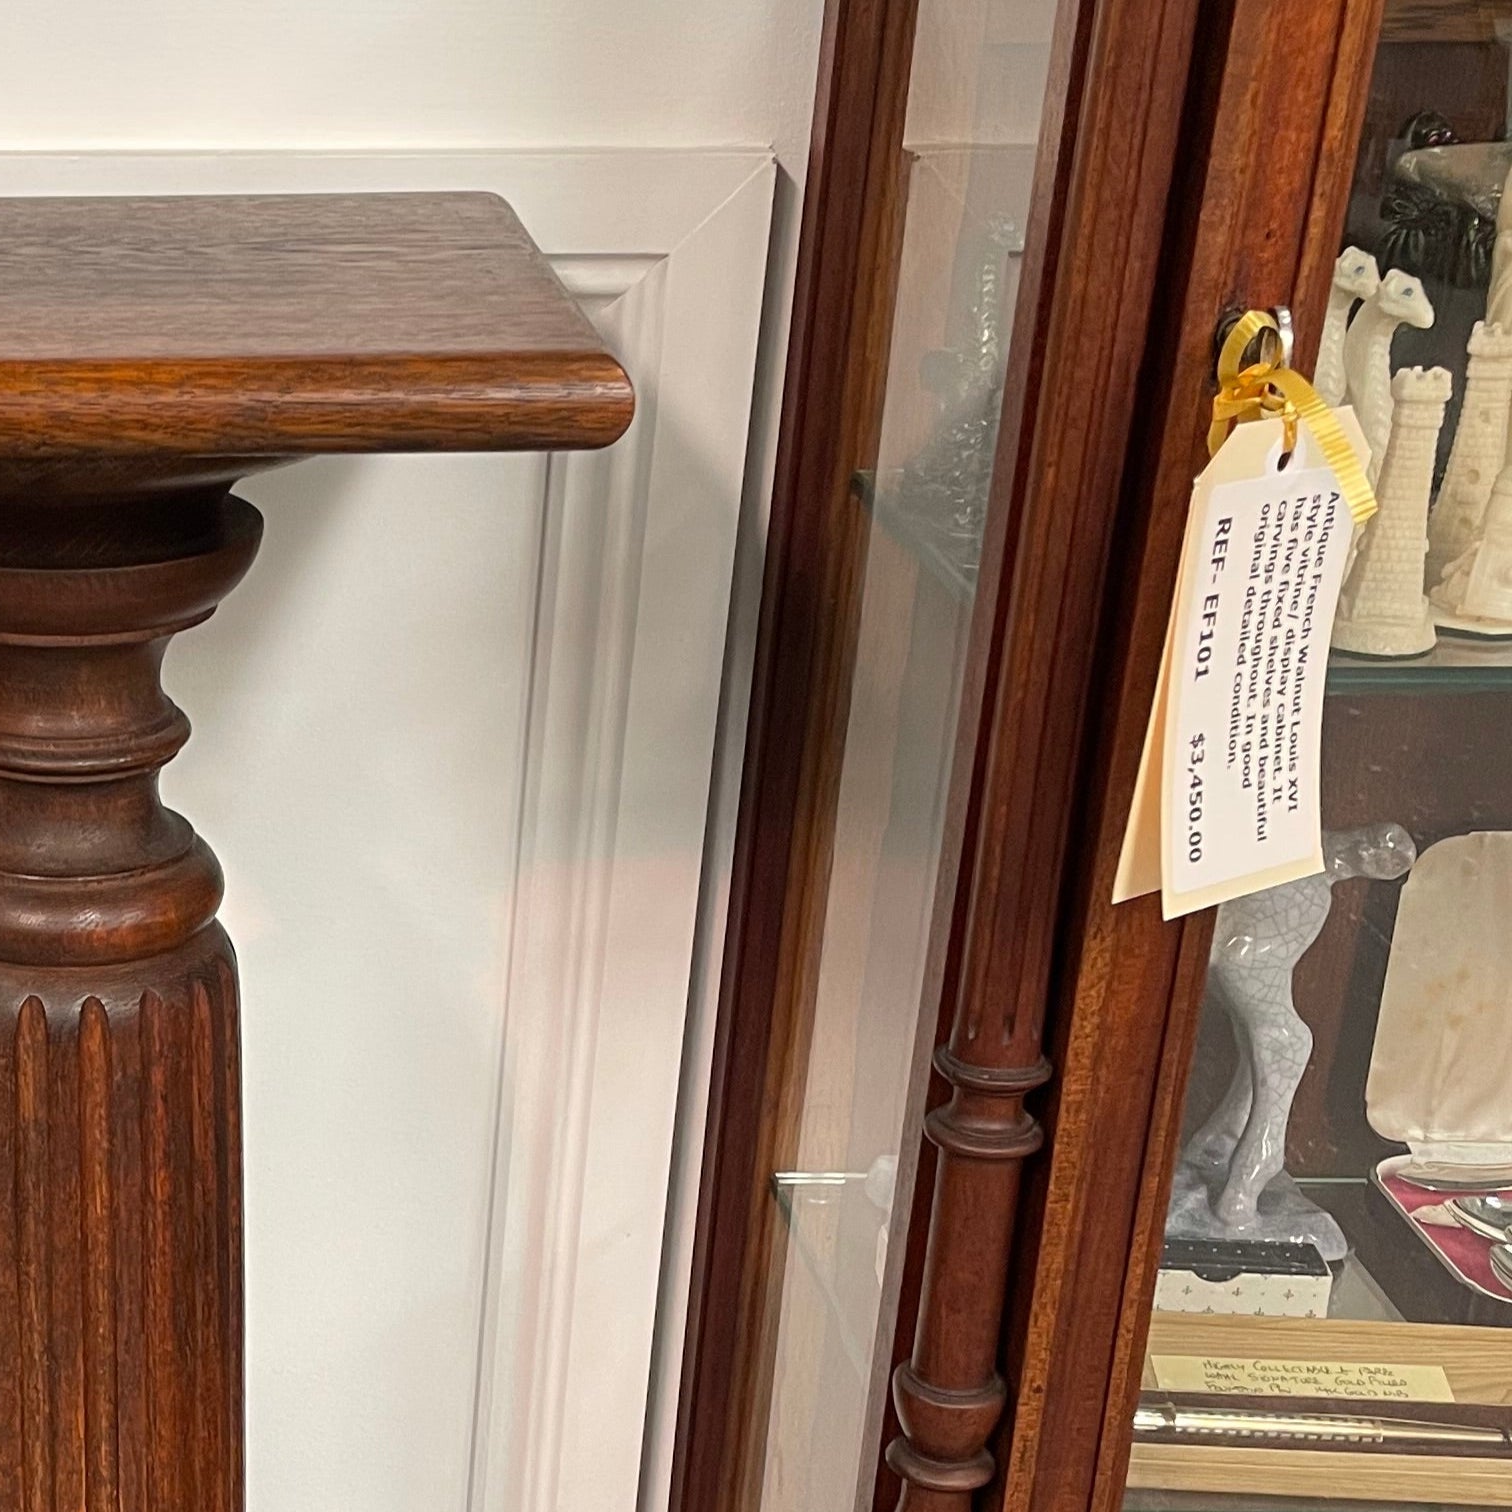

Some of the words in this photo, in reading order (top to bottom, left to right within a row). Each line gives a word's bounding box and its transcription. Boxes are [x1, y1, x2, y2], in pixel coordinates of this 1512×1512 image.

[1248, 504, 1271, 580] original
[1263, 500, 1288, 585] carvings
[1290, 497, 1307, 532] has
[1304, 494, 1322, 542] style
[1314, 491, 1340, 568] Antique
[1210, 516, 1233, 584] REF-
[1282, 538, 1298, 574] five
[1287, 546, 1312, 620] vitrine/
[1194, 594, 1220, 682] EF101
[1236, 586, 1257, 666] detailed
[1272, 581, 1290, 629] fixed
[1300, 573, 1322, 640] French
[1246, 589, 1272, 708] throughout.
[1261, 635, 1280, 709] shelves
[1276, 629, 1295, 696] display
[1291, 645, 1310, 716] Walnut
[1227, 672, 1245, 770] condition.
[1245, 713, 1256, 735] In
[1259, 714, 1271, 749] and
[1272, 703, 1286, 780] cabinet.
[1288, 721, 1301, 772] Louis
[1187, 732, 1206, 864] $3,450.00
[1241, 741, 1253, 789] good
[1257, 756, 1269, 842] beautiful
[1272, 787, 1283, 804] It
[1288, 778, 1299, 813] XVI
